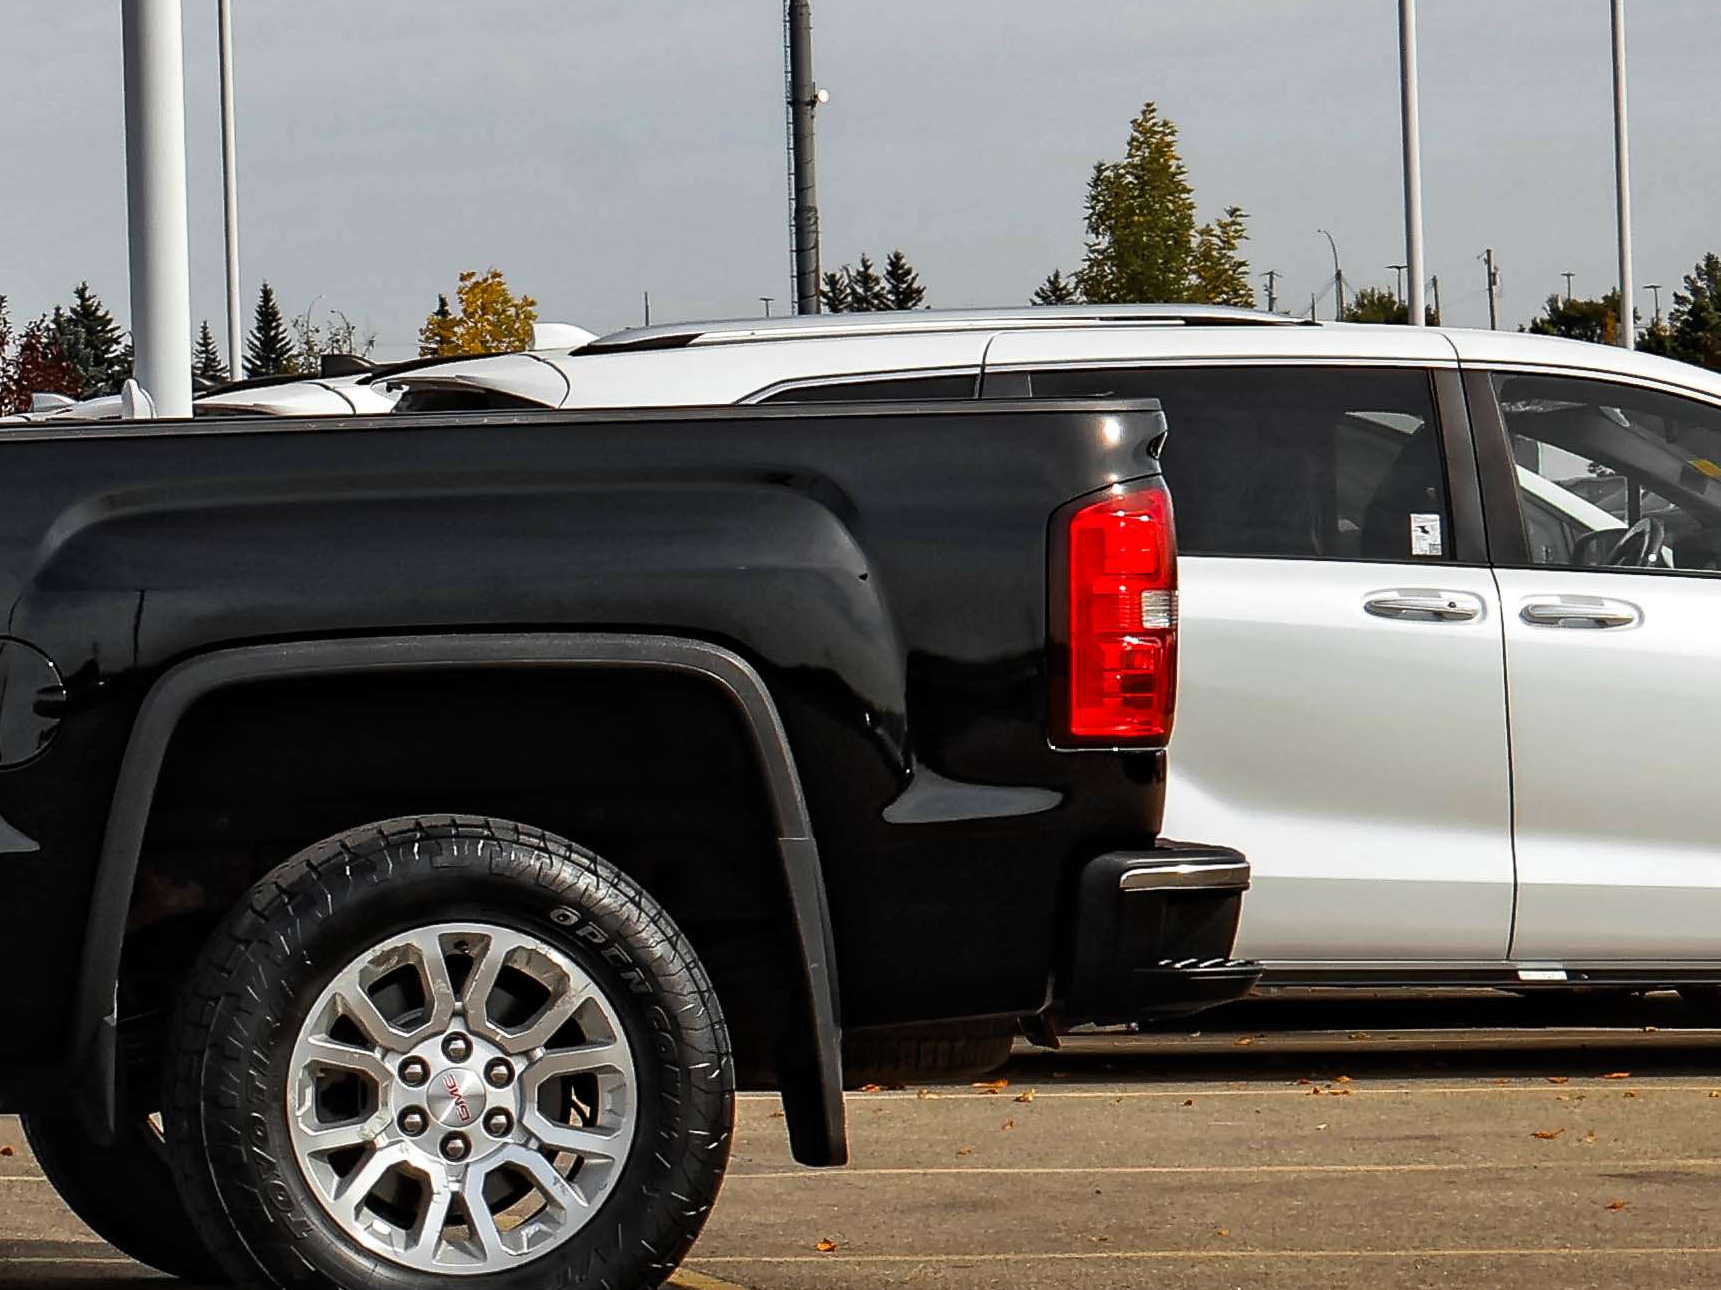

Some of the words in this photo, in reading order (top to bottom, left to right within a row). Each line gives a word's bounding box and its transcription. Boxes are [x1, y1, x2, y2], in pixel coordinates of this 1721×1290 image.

[549, 903, 655, 998] OPEN
[442, 1072, 471, 1122] GMC
[246, 1111, 314, 1243] TOYO
